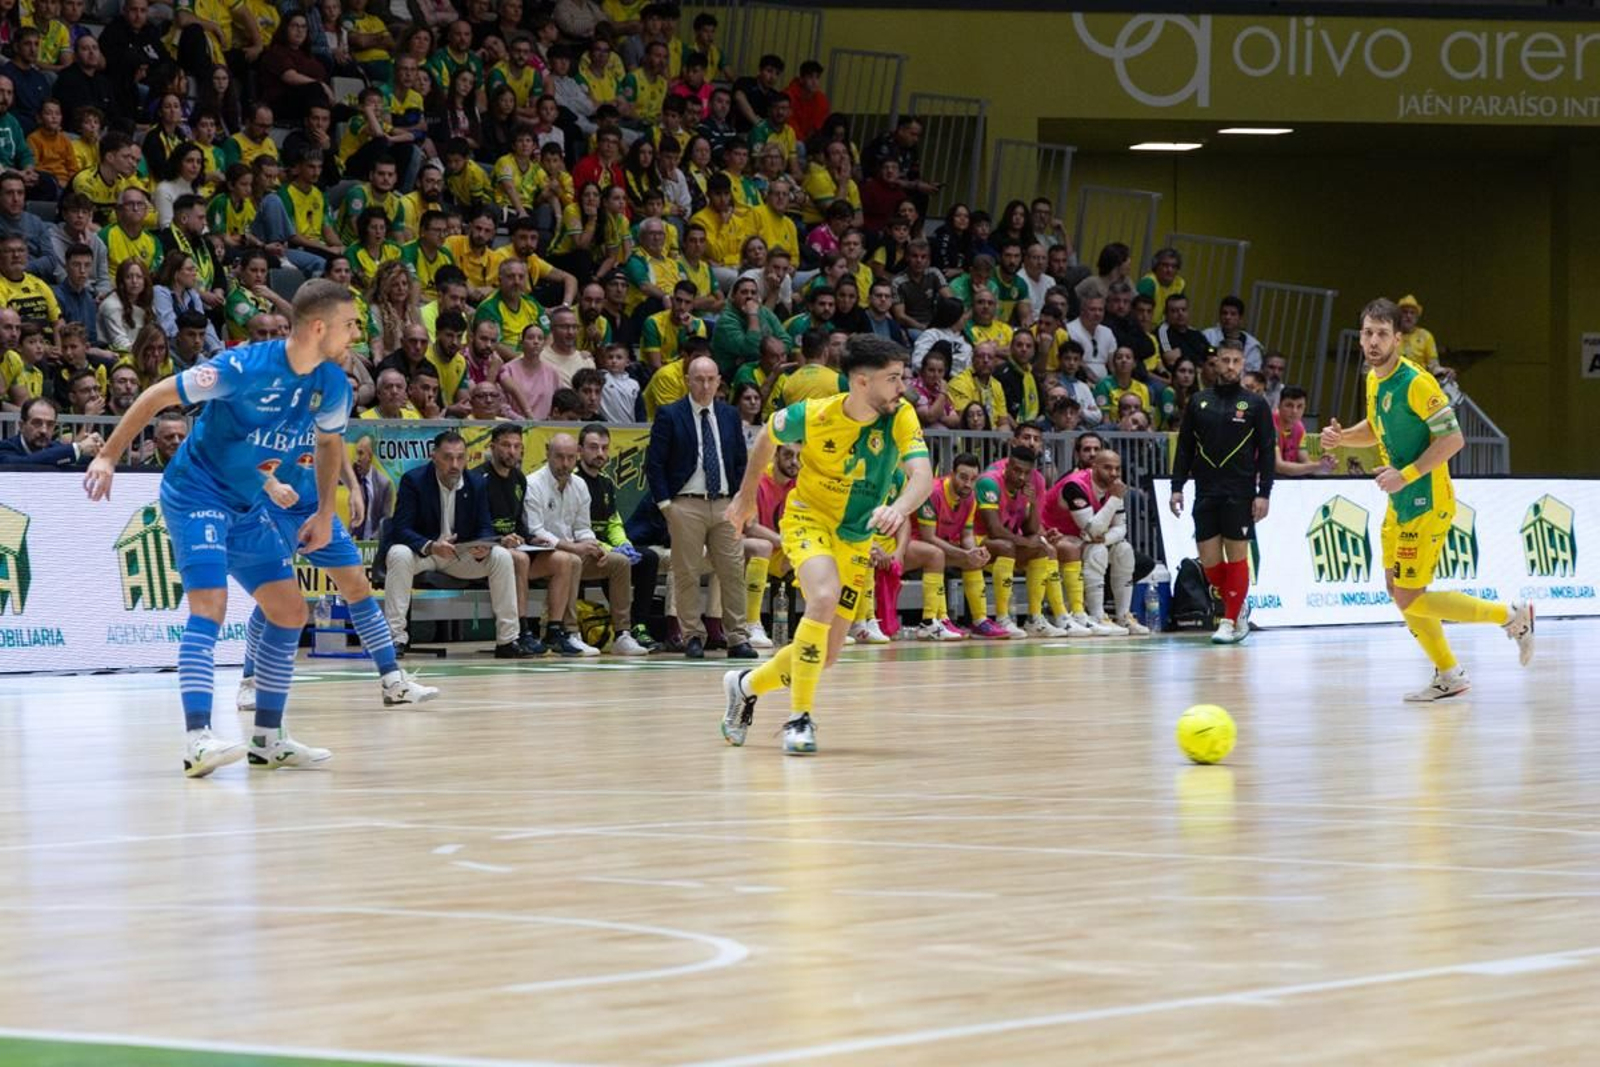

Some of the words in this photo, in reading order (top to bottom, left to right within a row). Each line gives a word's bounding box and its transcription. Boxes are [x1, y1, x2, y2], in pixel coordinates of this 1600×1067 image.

[1232, 16, 1412, 78] olivo
[1397, 88, 1453, 119] JAÉN
[1458, 89, 1558, 117] PARAÍSO
[107, 624, 164, 644] AGENCIA
